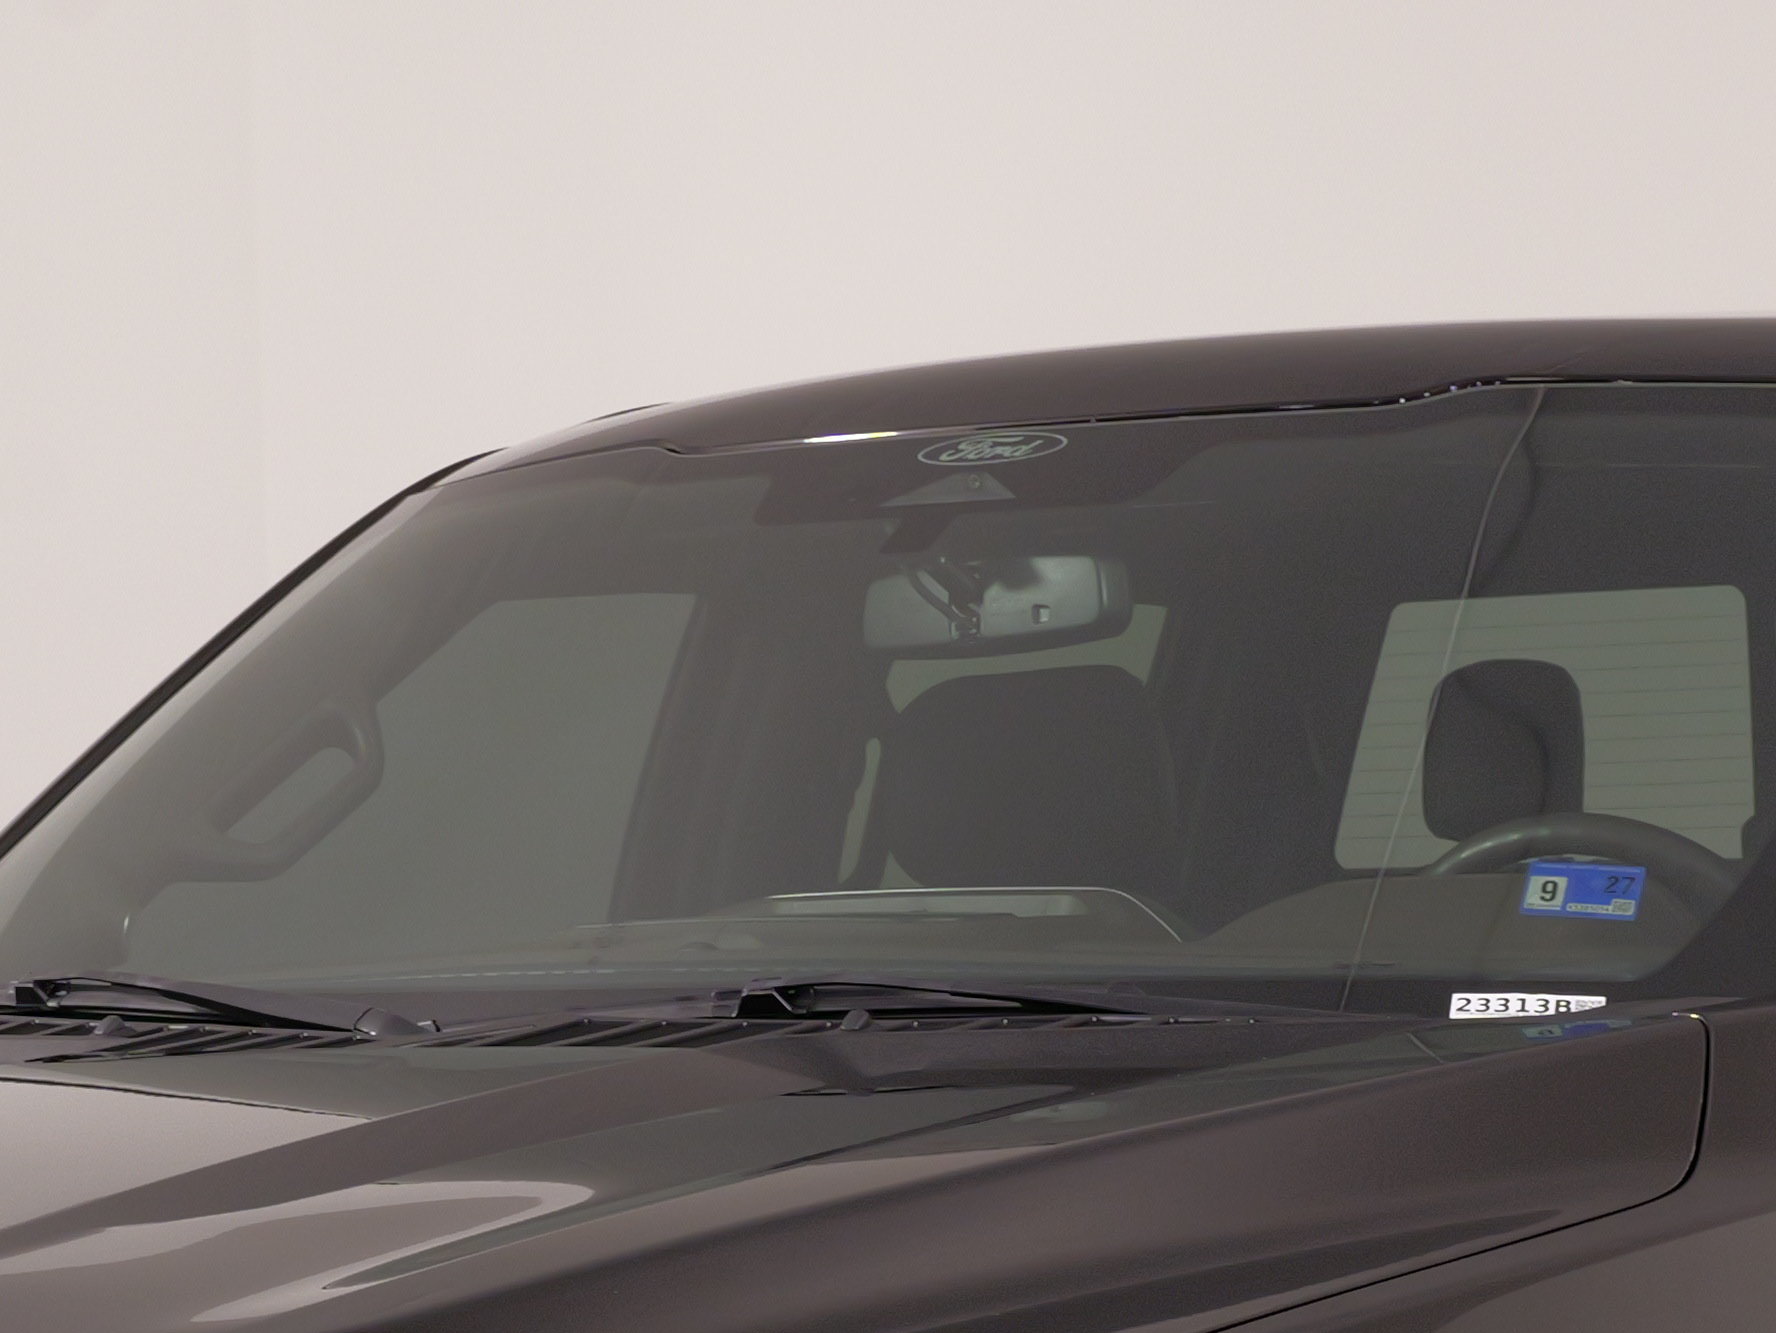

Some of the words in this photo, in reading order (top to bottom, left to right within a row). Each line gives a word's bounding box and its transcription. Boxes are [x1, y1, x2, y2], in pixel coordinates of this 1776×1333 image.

[939, 436, 1044, 462] Ford
[1539, 879, 1558, 902] 9
[1603, 875, 1637, 896] 27
